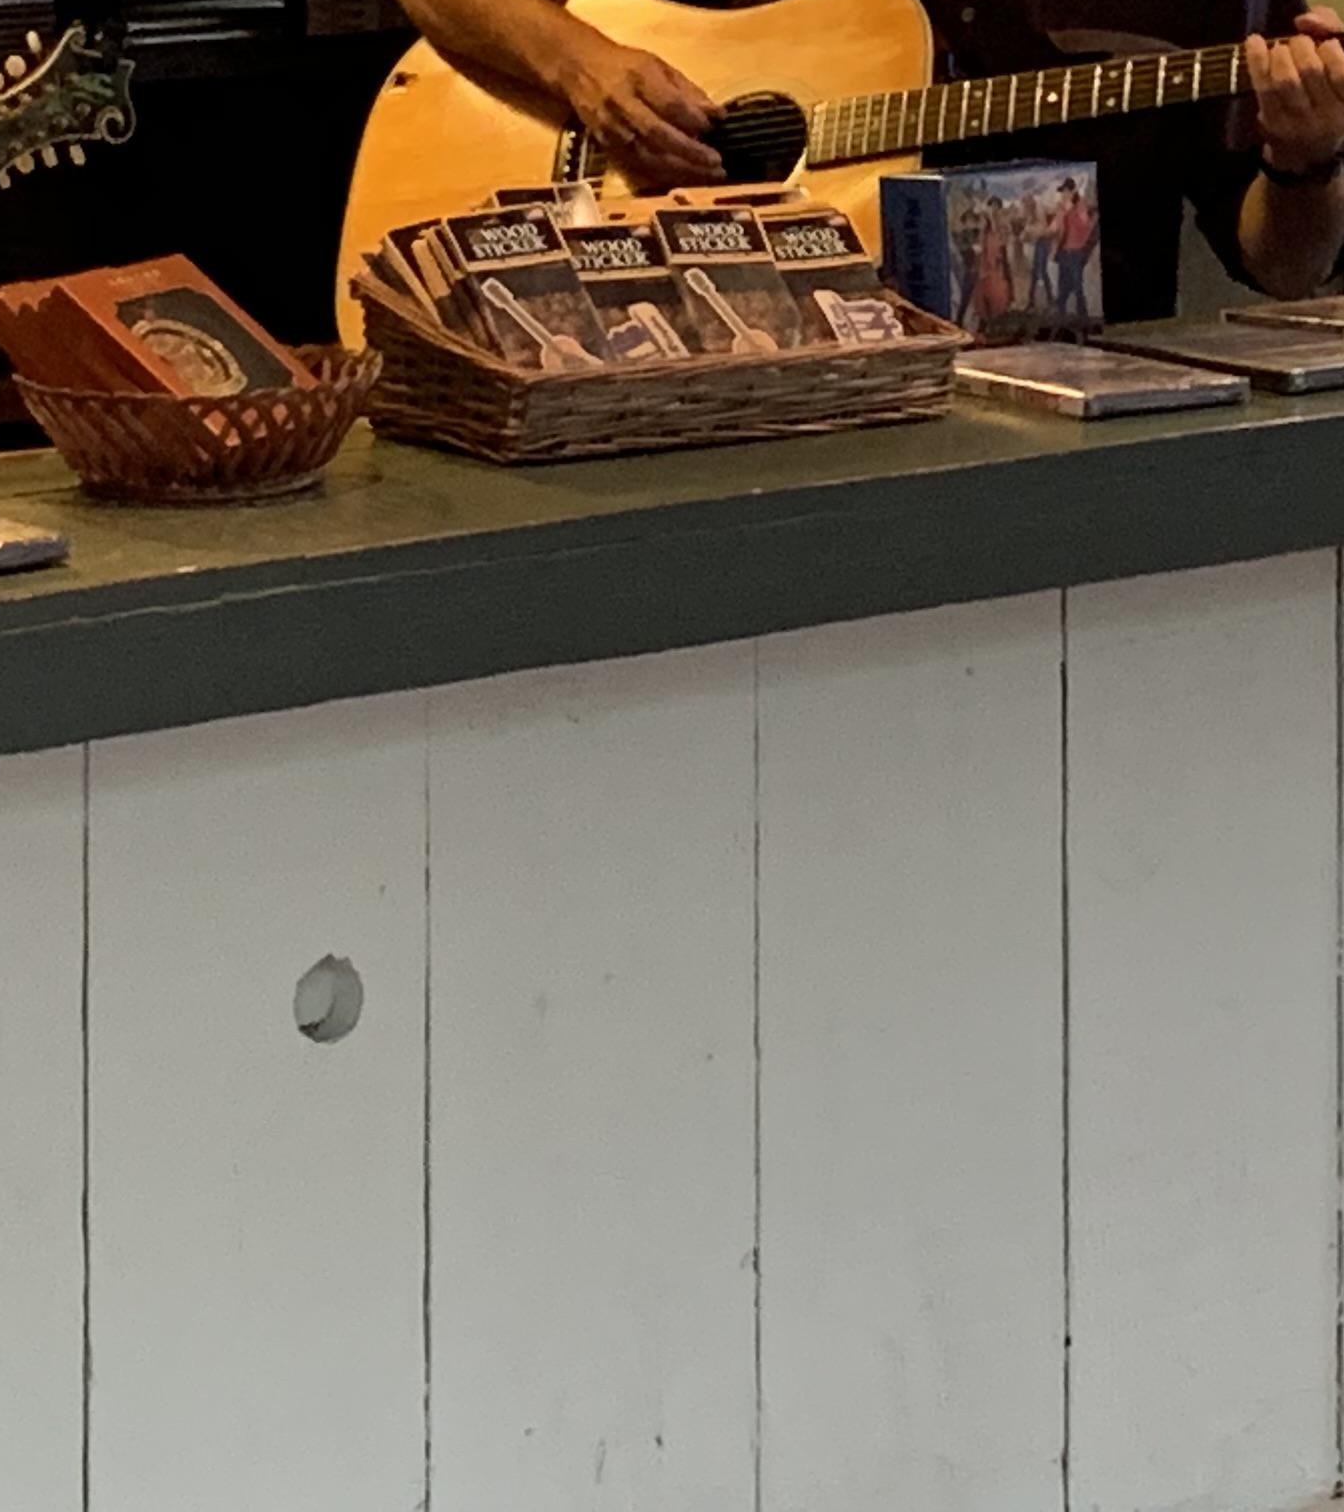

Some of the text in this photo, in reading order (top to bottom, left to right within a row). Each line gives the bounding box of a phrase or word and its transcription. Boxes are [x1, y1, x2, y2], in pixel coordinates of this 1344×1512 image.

[481, 223, 539, 242] WOOD
[688, 222, 744, 238] WOOD
[782, 226, 840, 244] WOOD
[581, 239, 643, 254] WOOD
